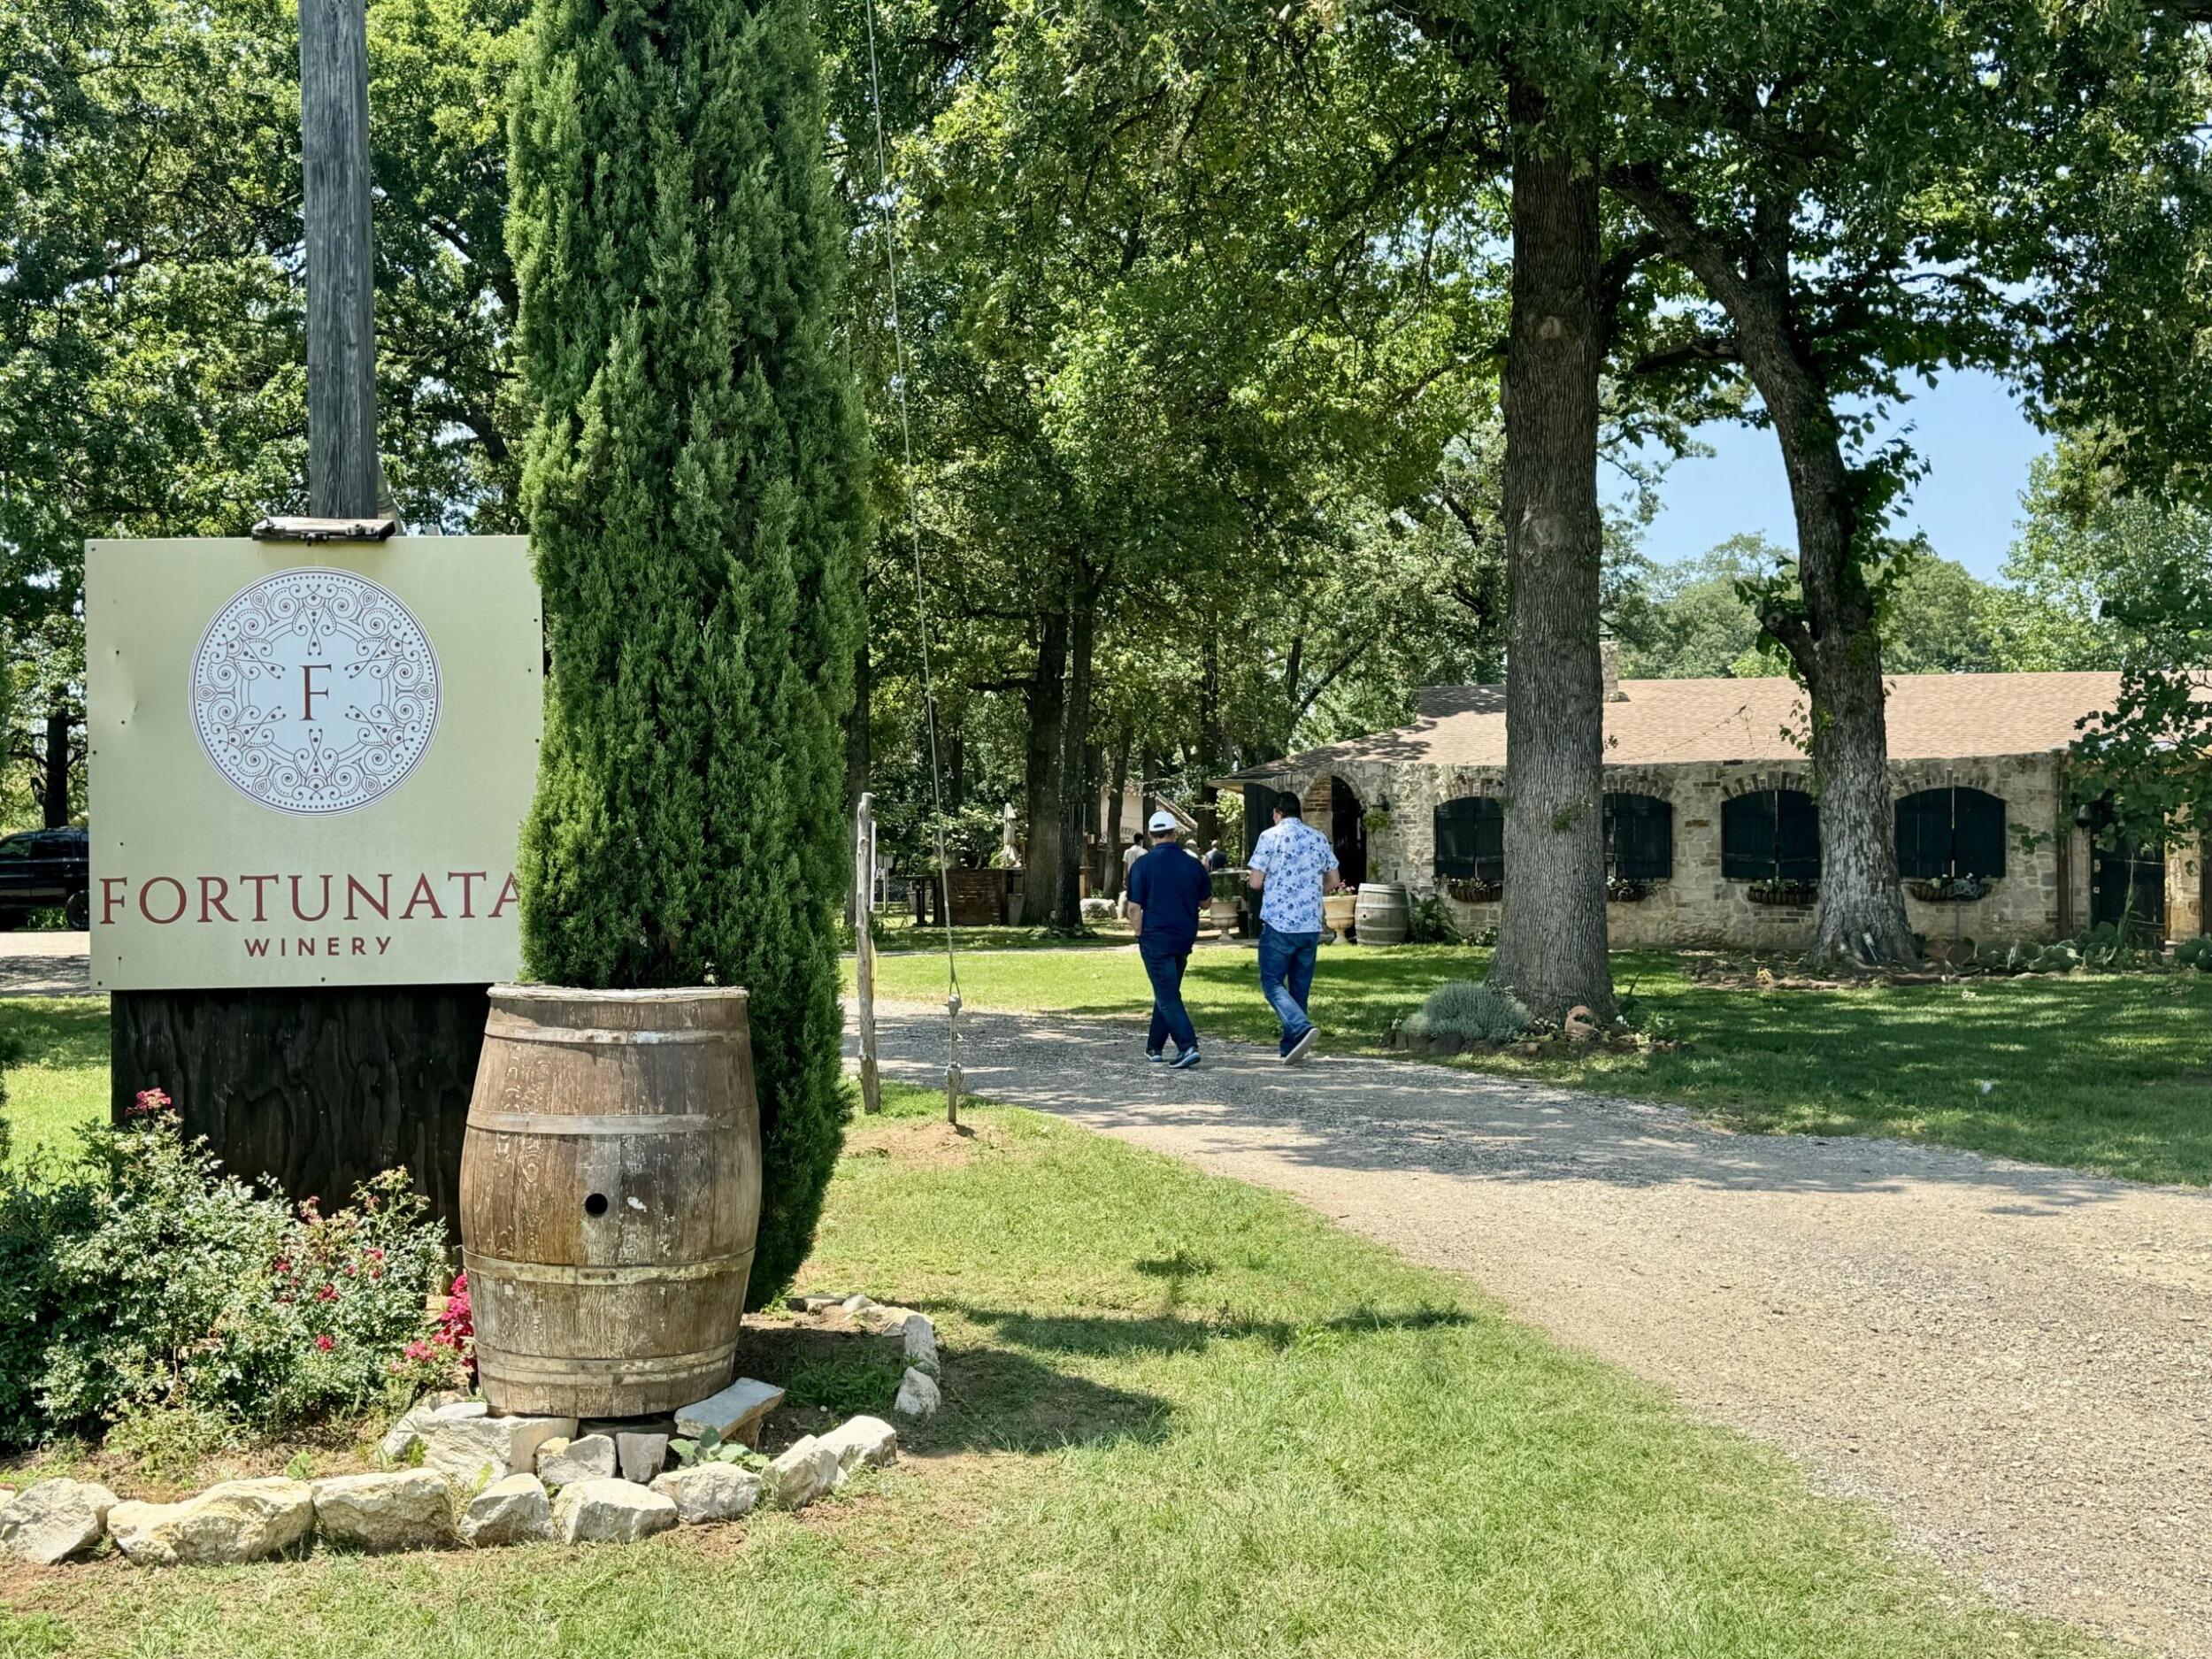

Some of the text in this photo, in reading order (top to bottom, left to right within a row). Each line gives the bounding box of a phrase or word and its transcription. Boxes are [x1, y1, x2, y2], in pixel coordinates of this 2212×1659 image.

[298, 664, 332, 721] F
[99, 871, 520, 925] FORTUNATA
[244, 936, 391, 957] WINERY
